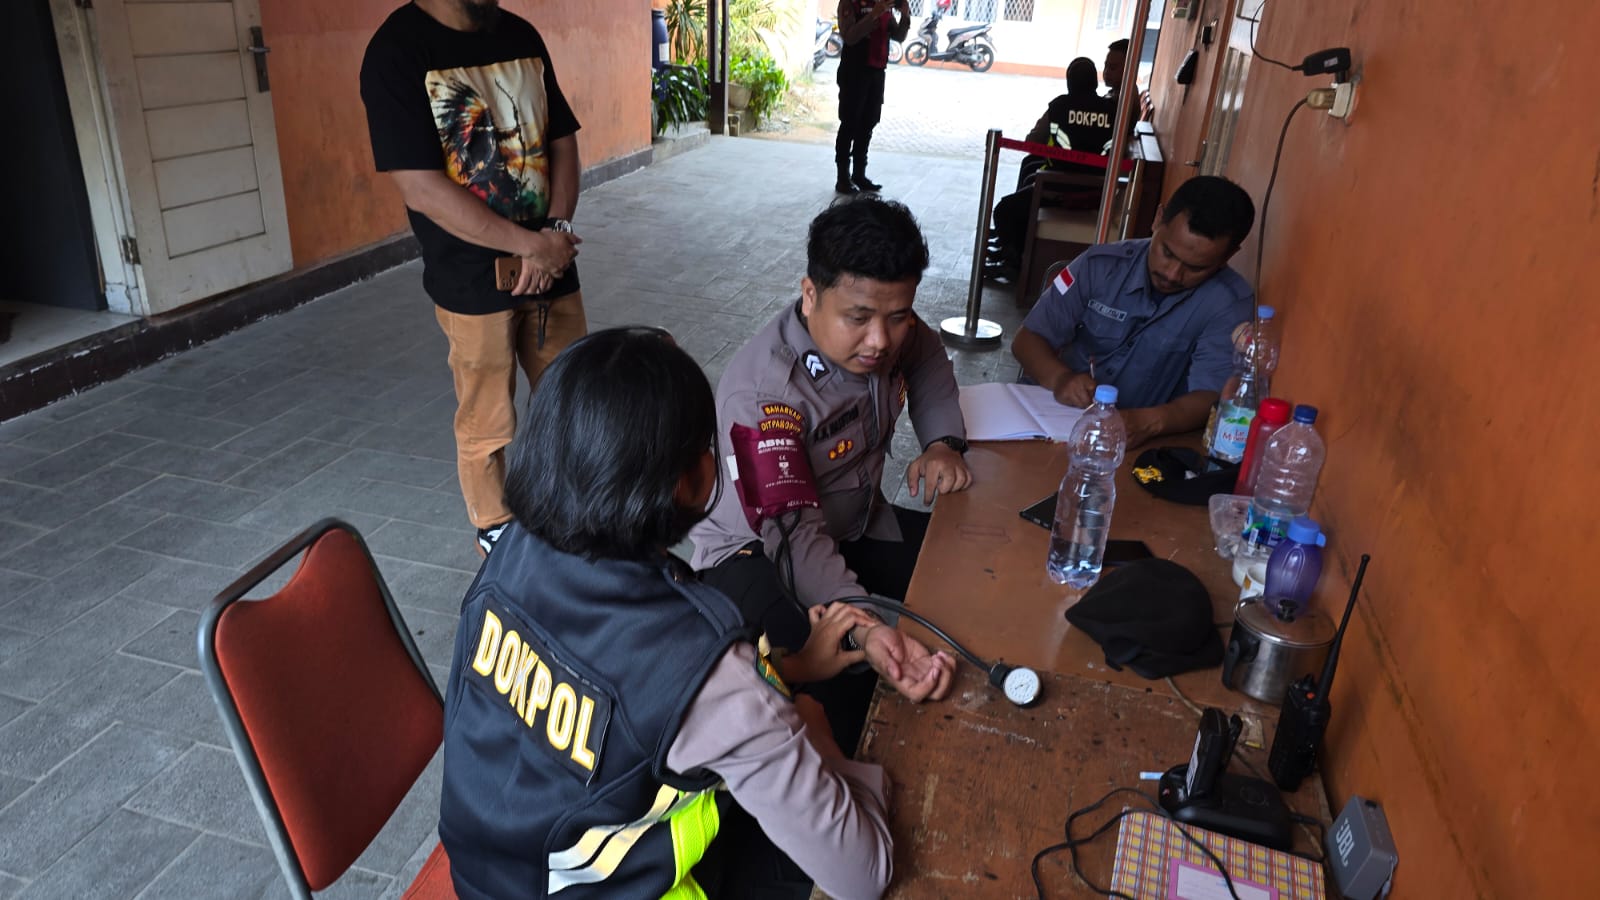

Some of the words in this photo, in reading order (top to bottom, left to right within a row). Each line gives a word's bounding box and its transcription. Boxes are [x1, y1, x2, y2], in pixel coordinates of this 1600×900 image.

[1068, 110, 1110, 128] DOKPOL
[472, 609, 596, 772] DOKPOL
[1336, 819, 1355, 867] JBL
